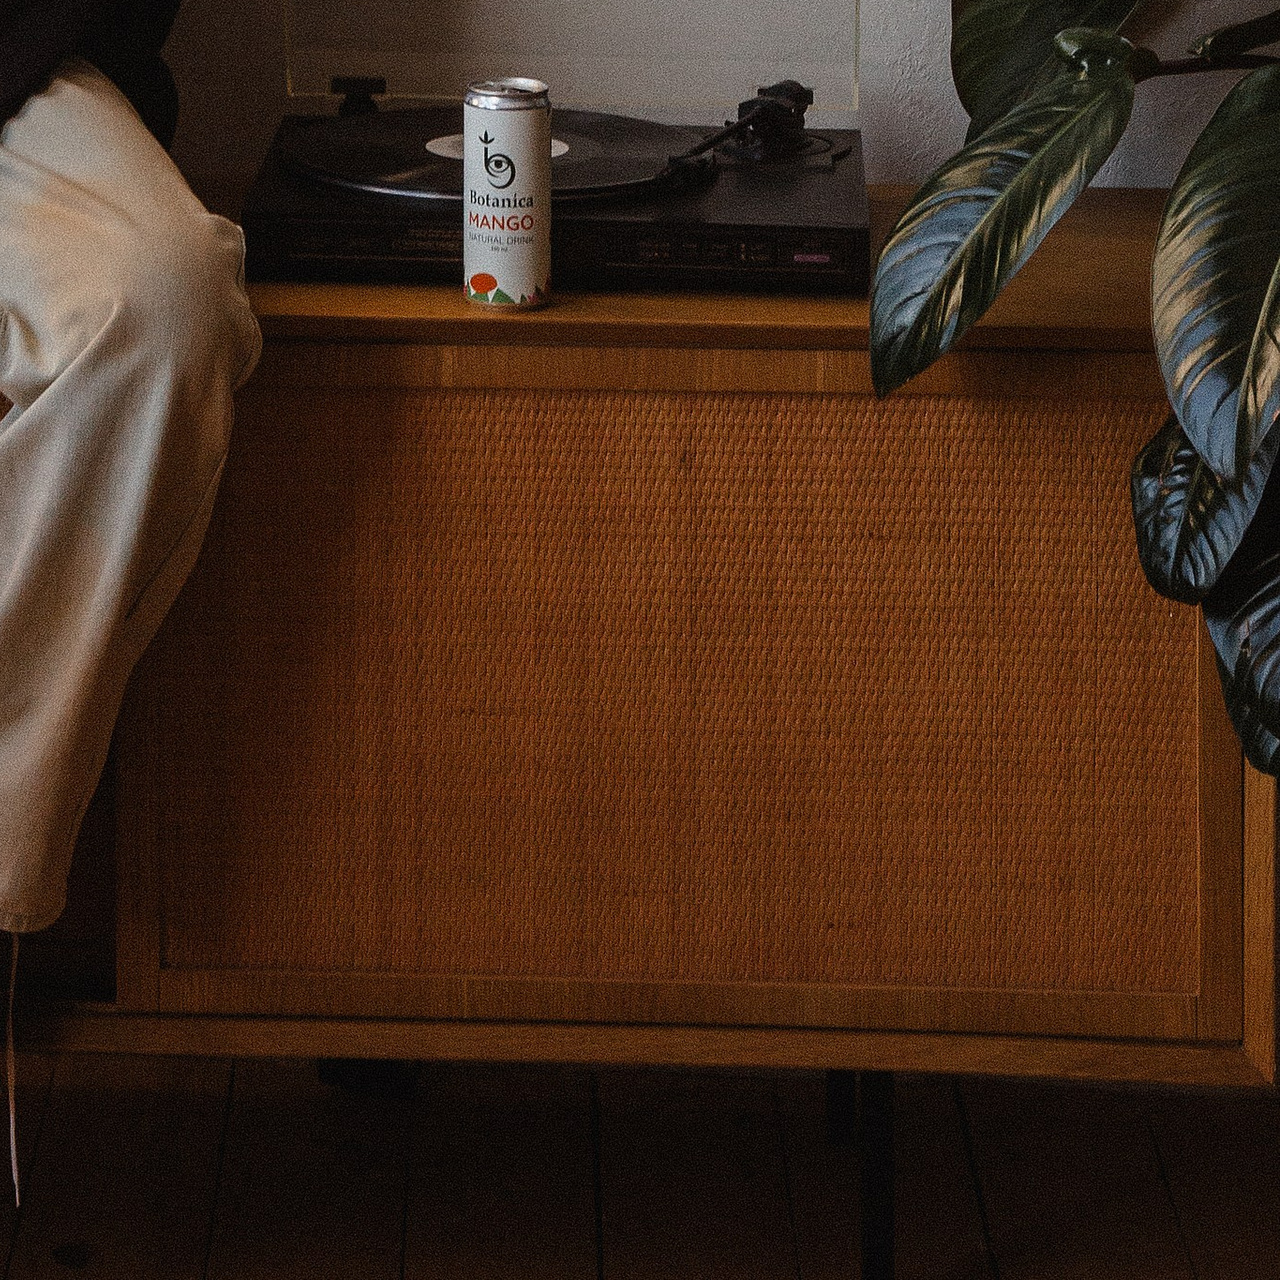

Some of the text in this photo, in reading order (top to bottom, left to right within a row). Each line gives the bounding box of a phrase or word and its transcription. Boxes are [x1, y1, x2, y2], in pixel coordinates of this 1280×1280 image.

[469, 189, 534, 208] Botanica
[468, 211, 534, 231] MANGO
[468, 232, 502, 244] NATURAL
[506, 235, 534, 245] DRINK
